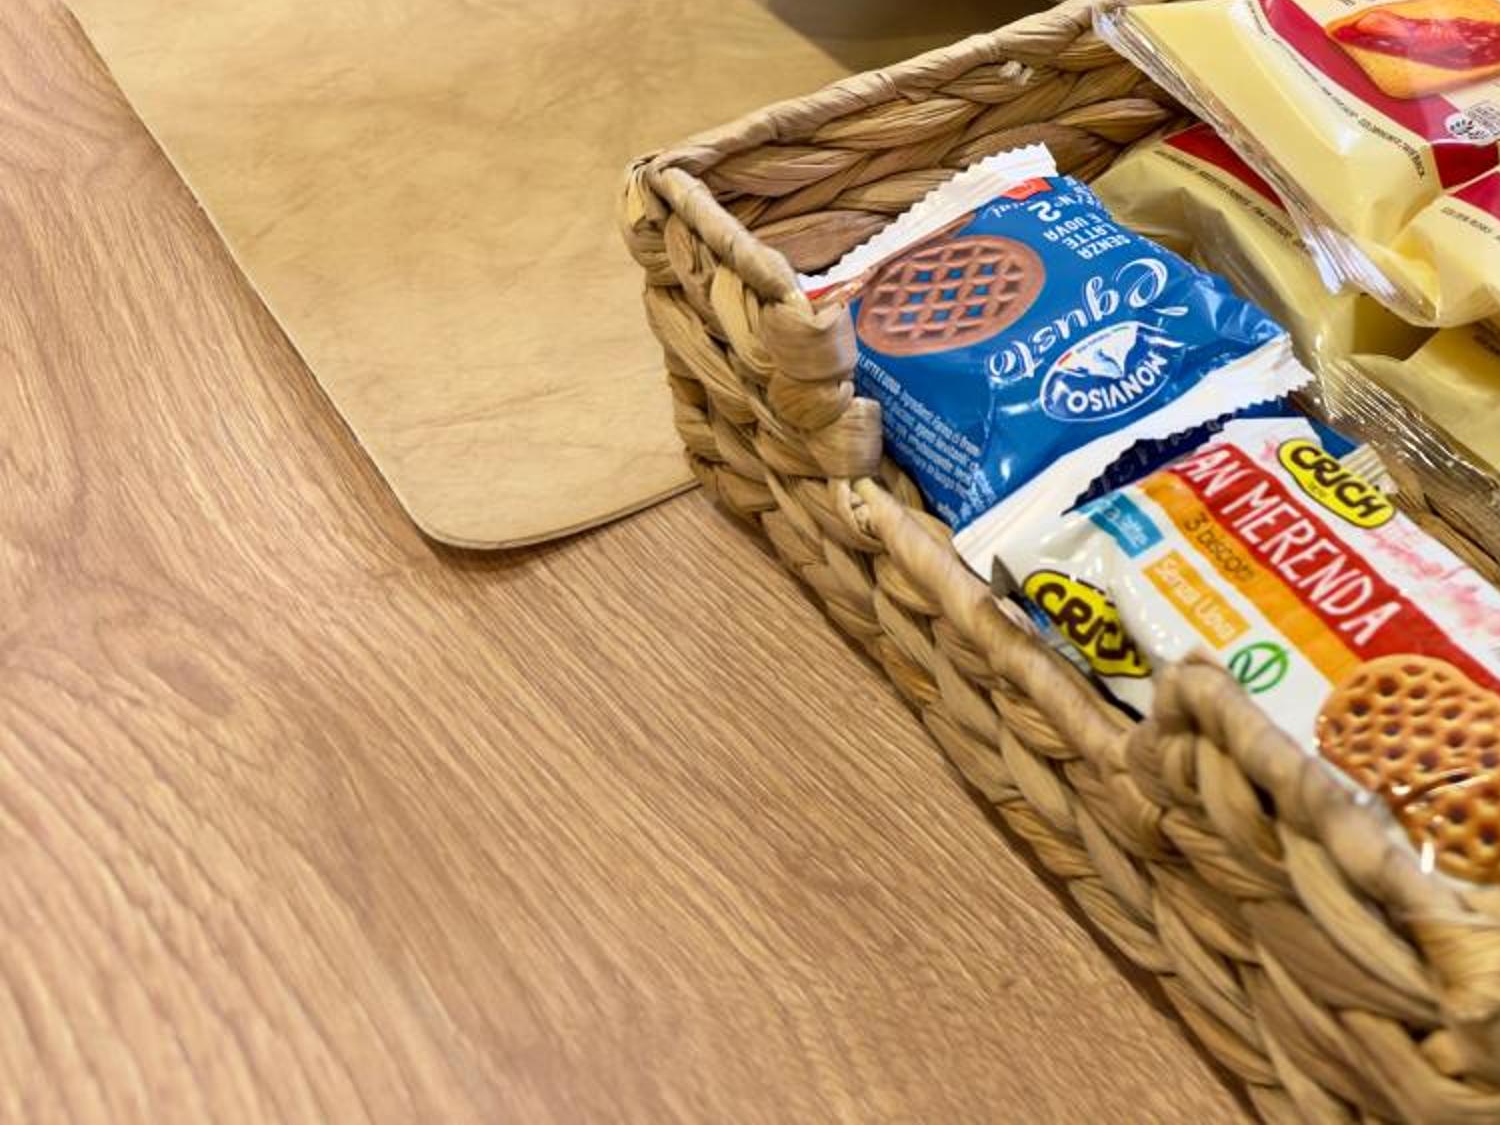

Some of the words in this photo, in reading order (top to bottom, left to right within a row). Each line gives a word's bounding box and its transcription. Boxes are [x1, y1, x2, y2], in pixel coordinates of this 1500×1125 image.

[1027, 198, 1062, 225] 2
[1042, 216, 1088, 243] UOVA
[1061, 222, 1117, 250] LATTE
[1076, 234, 1132, 261] SENZA
[1066, 349, 1170, 417] MONVISO
[1292, 445, 1388, 517] CRICH
[1182, 512, 1210, 532] 3
[1172, 449, 1254, 498] AN
[1219, 481, 1403, 649] MERENDA
